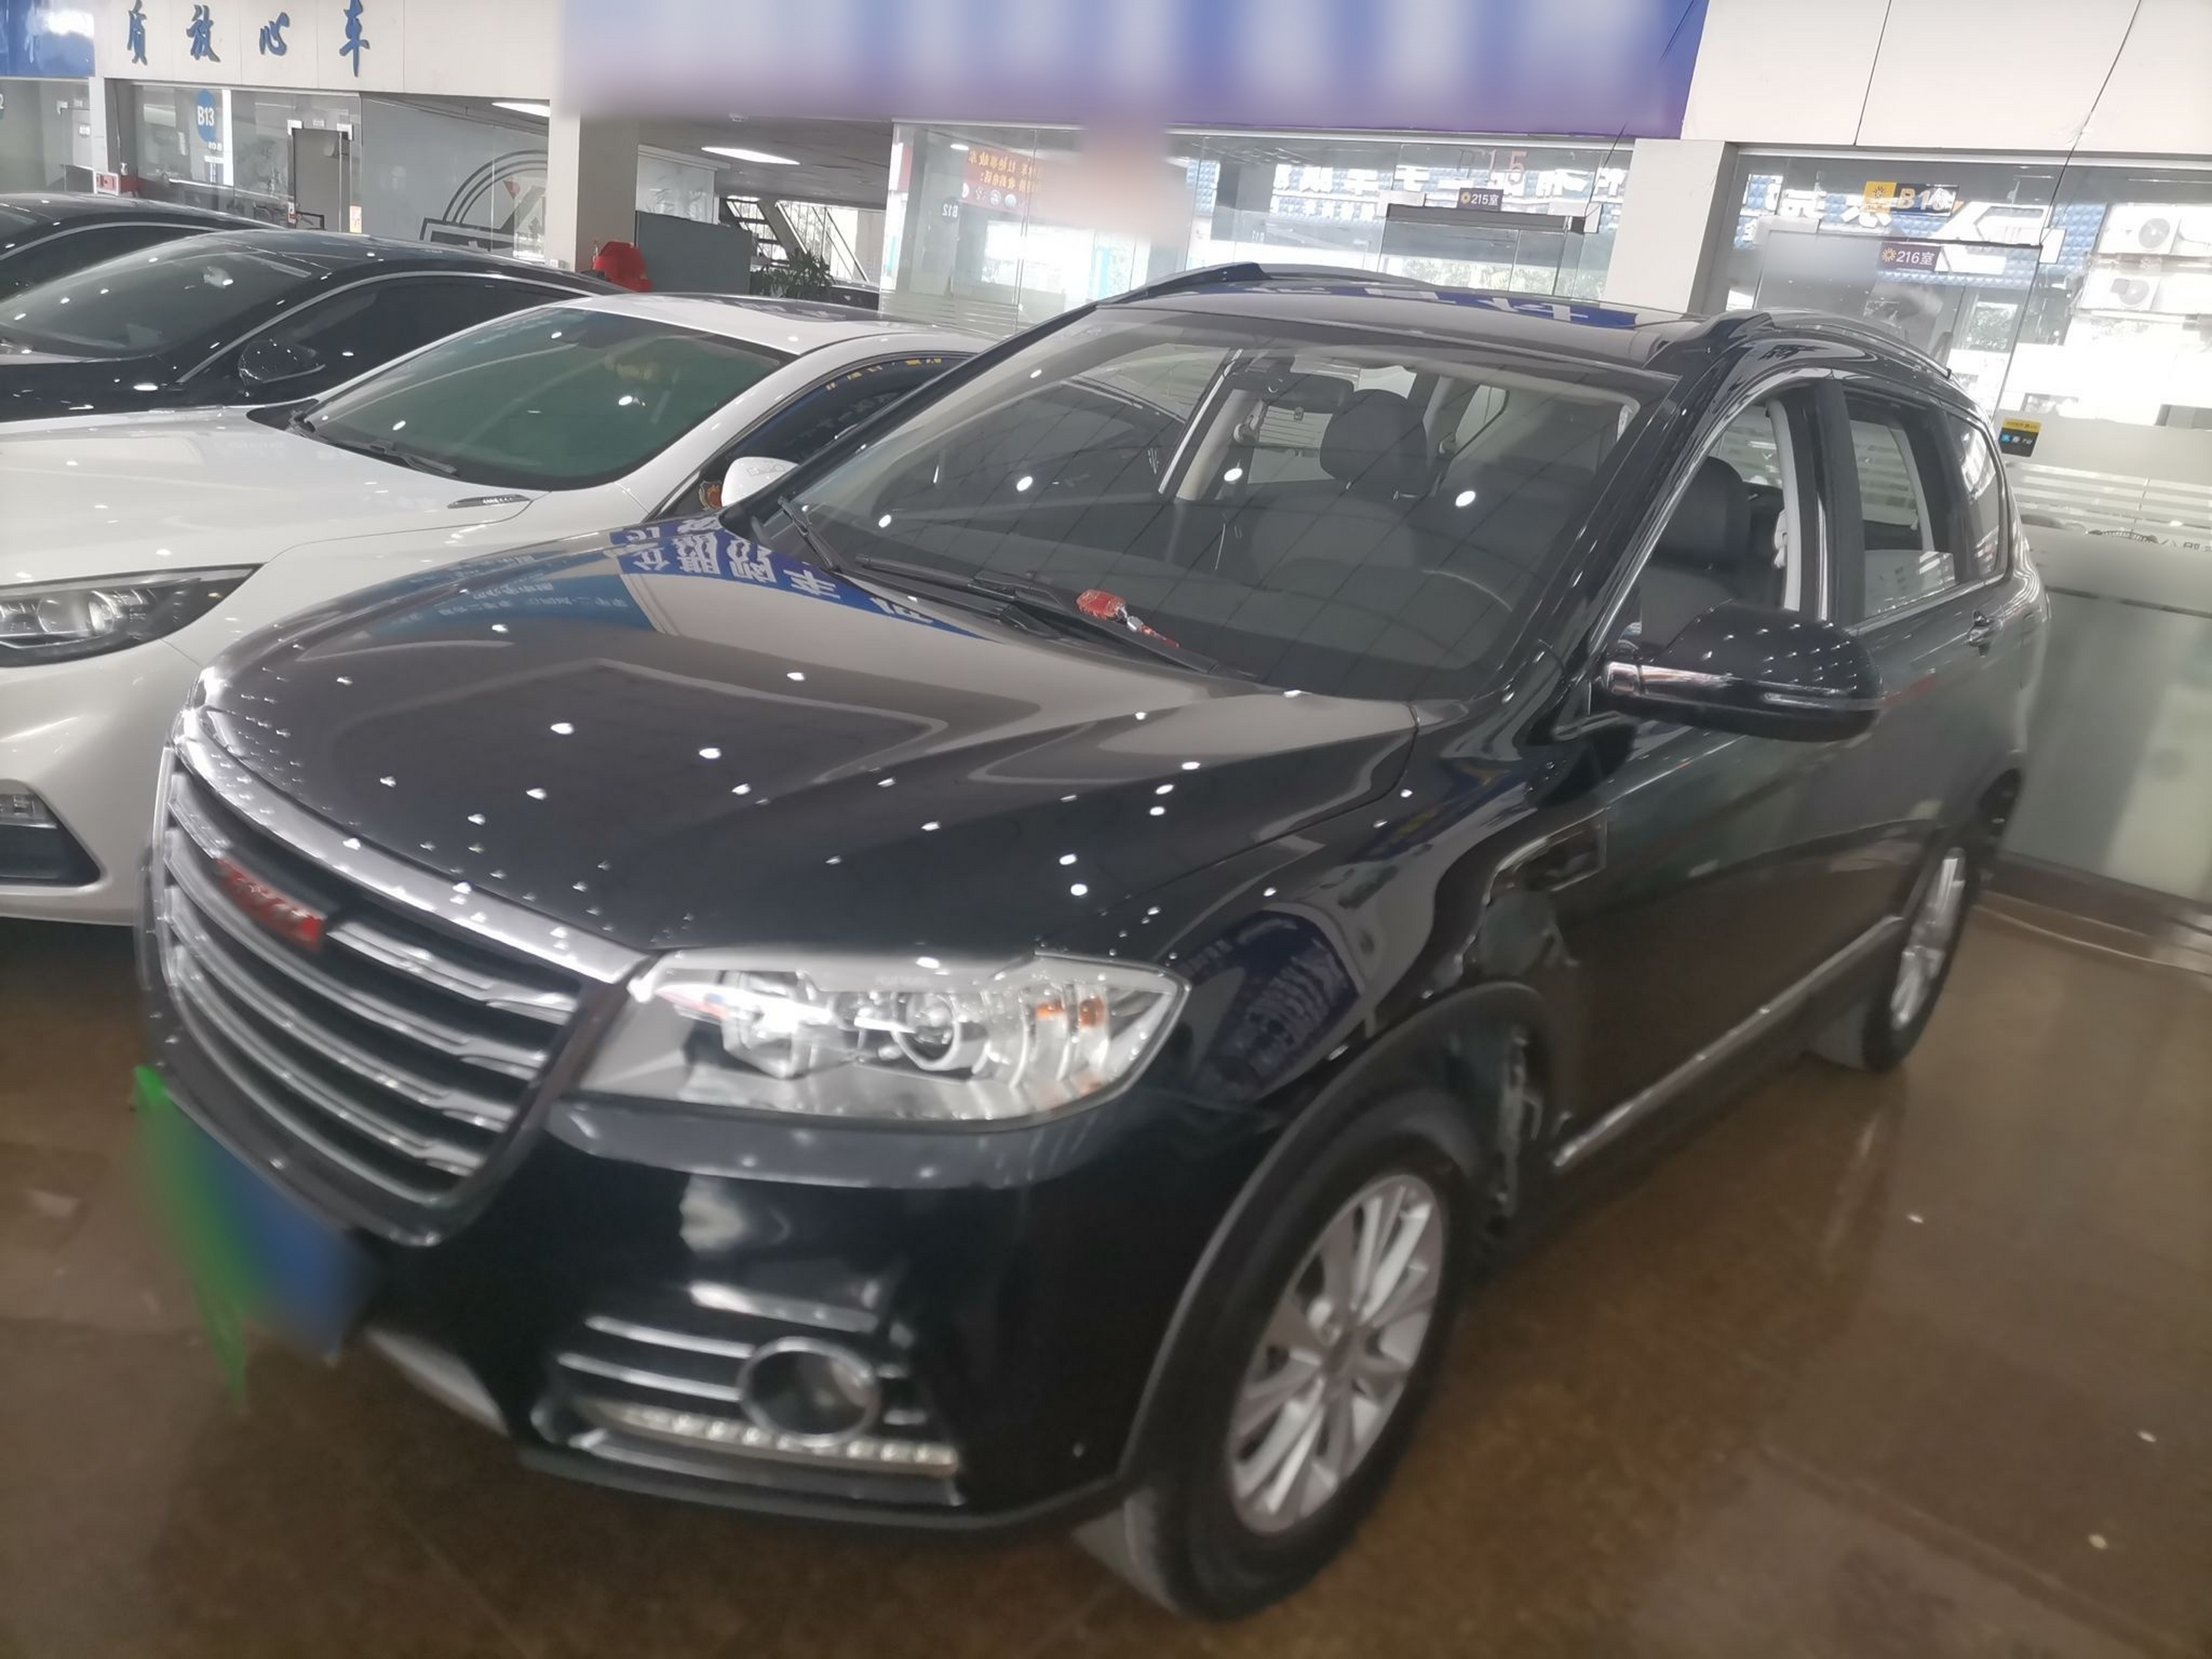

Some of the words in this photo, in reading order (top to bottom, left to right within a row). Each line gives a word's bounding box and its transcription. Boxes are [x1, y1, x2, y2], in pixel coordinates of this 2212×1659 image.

[197, 105, 214, 127] B13
[1471, 193, 1499, 206] 215室
[1896, 251, 1935, 266] 216室
